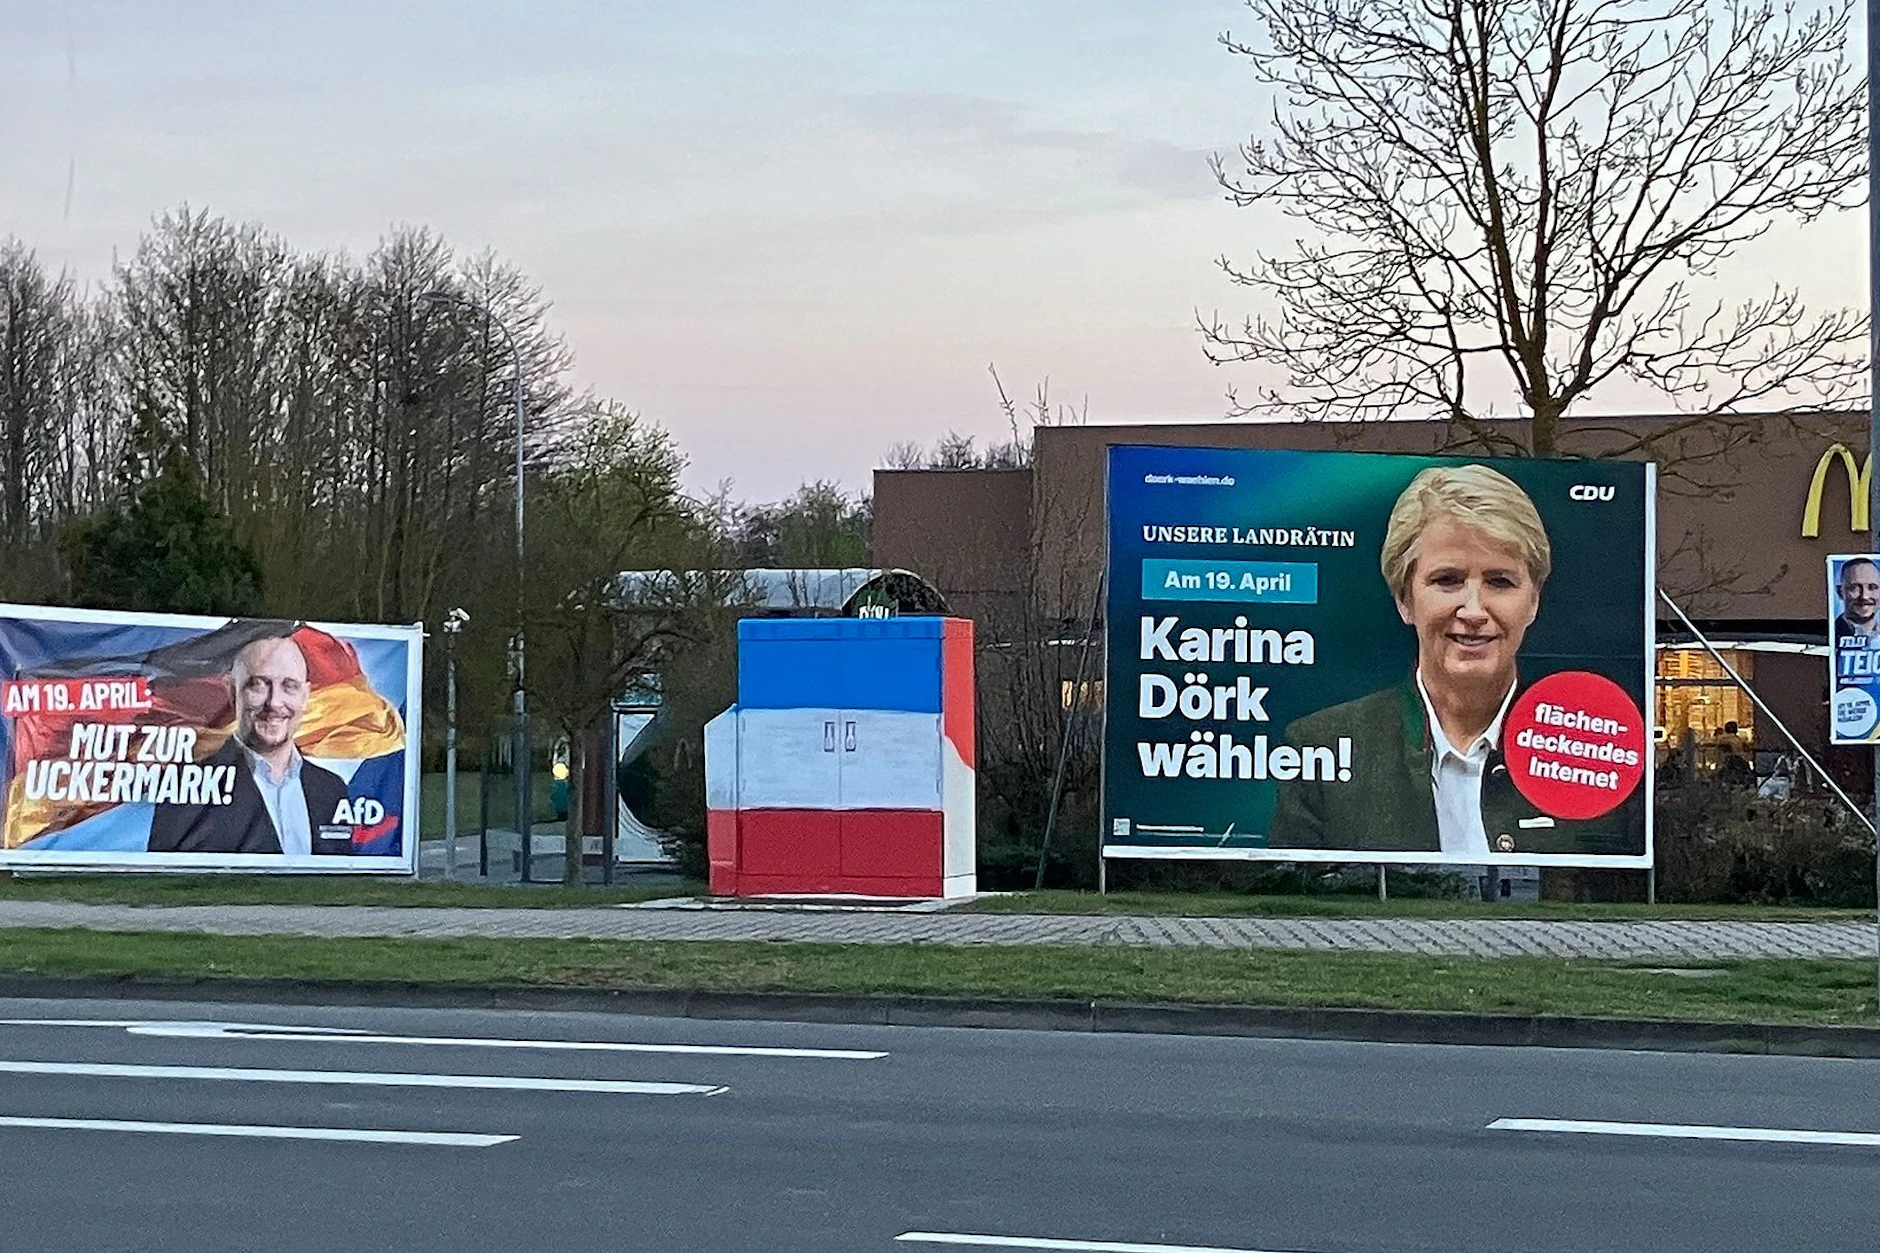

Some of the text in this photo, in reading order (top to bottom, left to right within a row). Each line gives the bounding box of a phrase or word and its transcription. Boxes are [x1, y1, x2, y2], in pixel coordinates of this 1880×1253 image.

[1569, 484, 1616, 501] CDU
[1142, 525, 1355, 547] UNSERE LANDRÄTIN
[1164, 570, 1292, 595] Am 19. April
[1140, 615, 1315, 665] Karina
[4, 681, 153, 713] AM 19. APRIL:
[1139, 672, 1270, 722] Dörk
[1534, 702, 1629, 736] flächen-
[69, 722, 198, 764] MUT ZUR
[1137, 730, 1352, 783] wählen!
[1516, 728, 1639, 767] deckendes
[25, 759, 238, 806] UCKERMARK!
[1528, 756, 1620, 790] Internet
[332, 796, 385, 825] AfD
